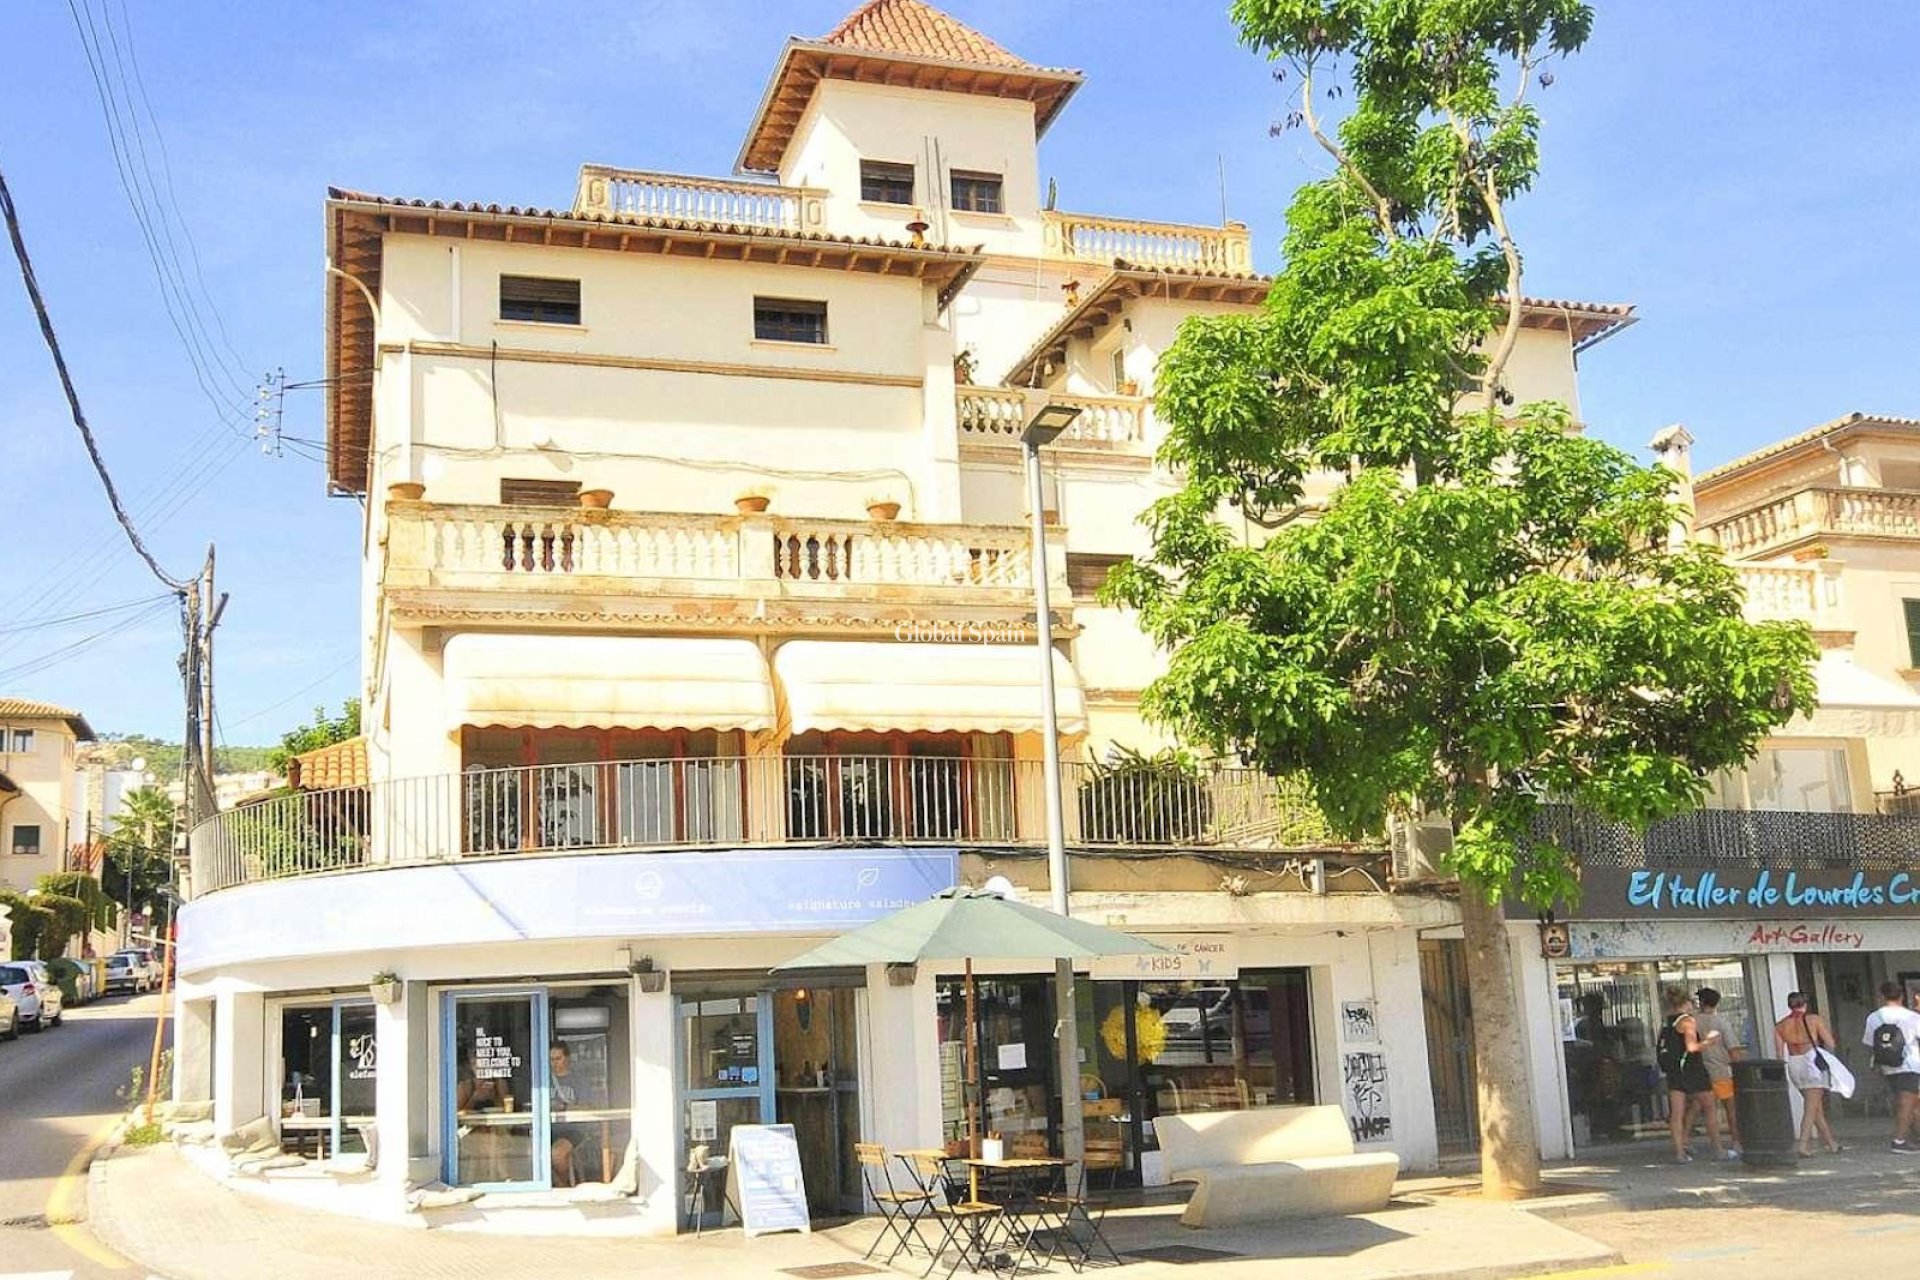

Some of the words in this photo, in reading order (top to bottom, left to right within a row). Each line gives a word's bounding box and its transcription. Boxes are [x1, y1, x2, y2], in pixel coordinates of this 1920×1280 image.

[1629, 871, 1664, 909] El
[1669, 871, 1741, 909] taller
[1747, 871, 1779, 909] de
[1785, 871, 1884, 909] Lourdes
[1788, 925, 1864, 948] Gallery
